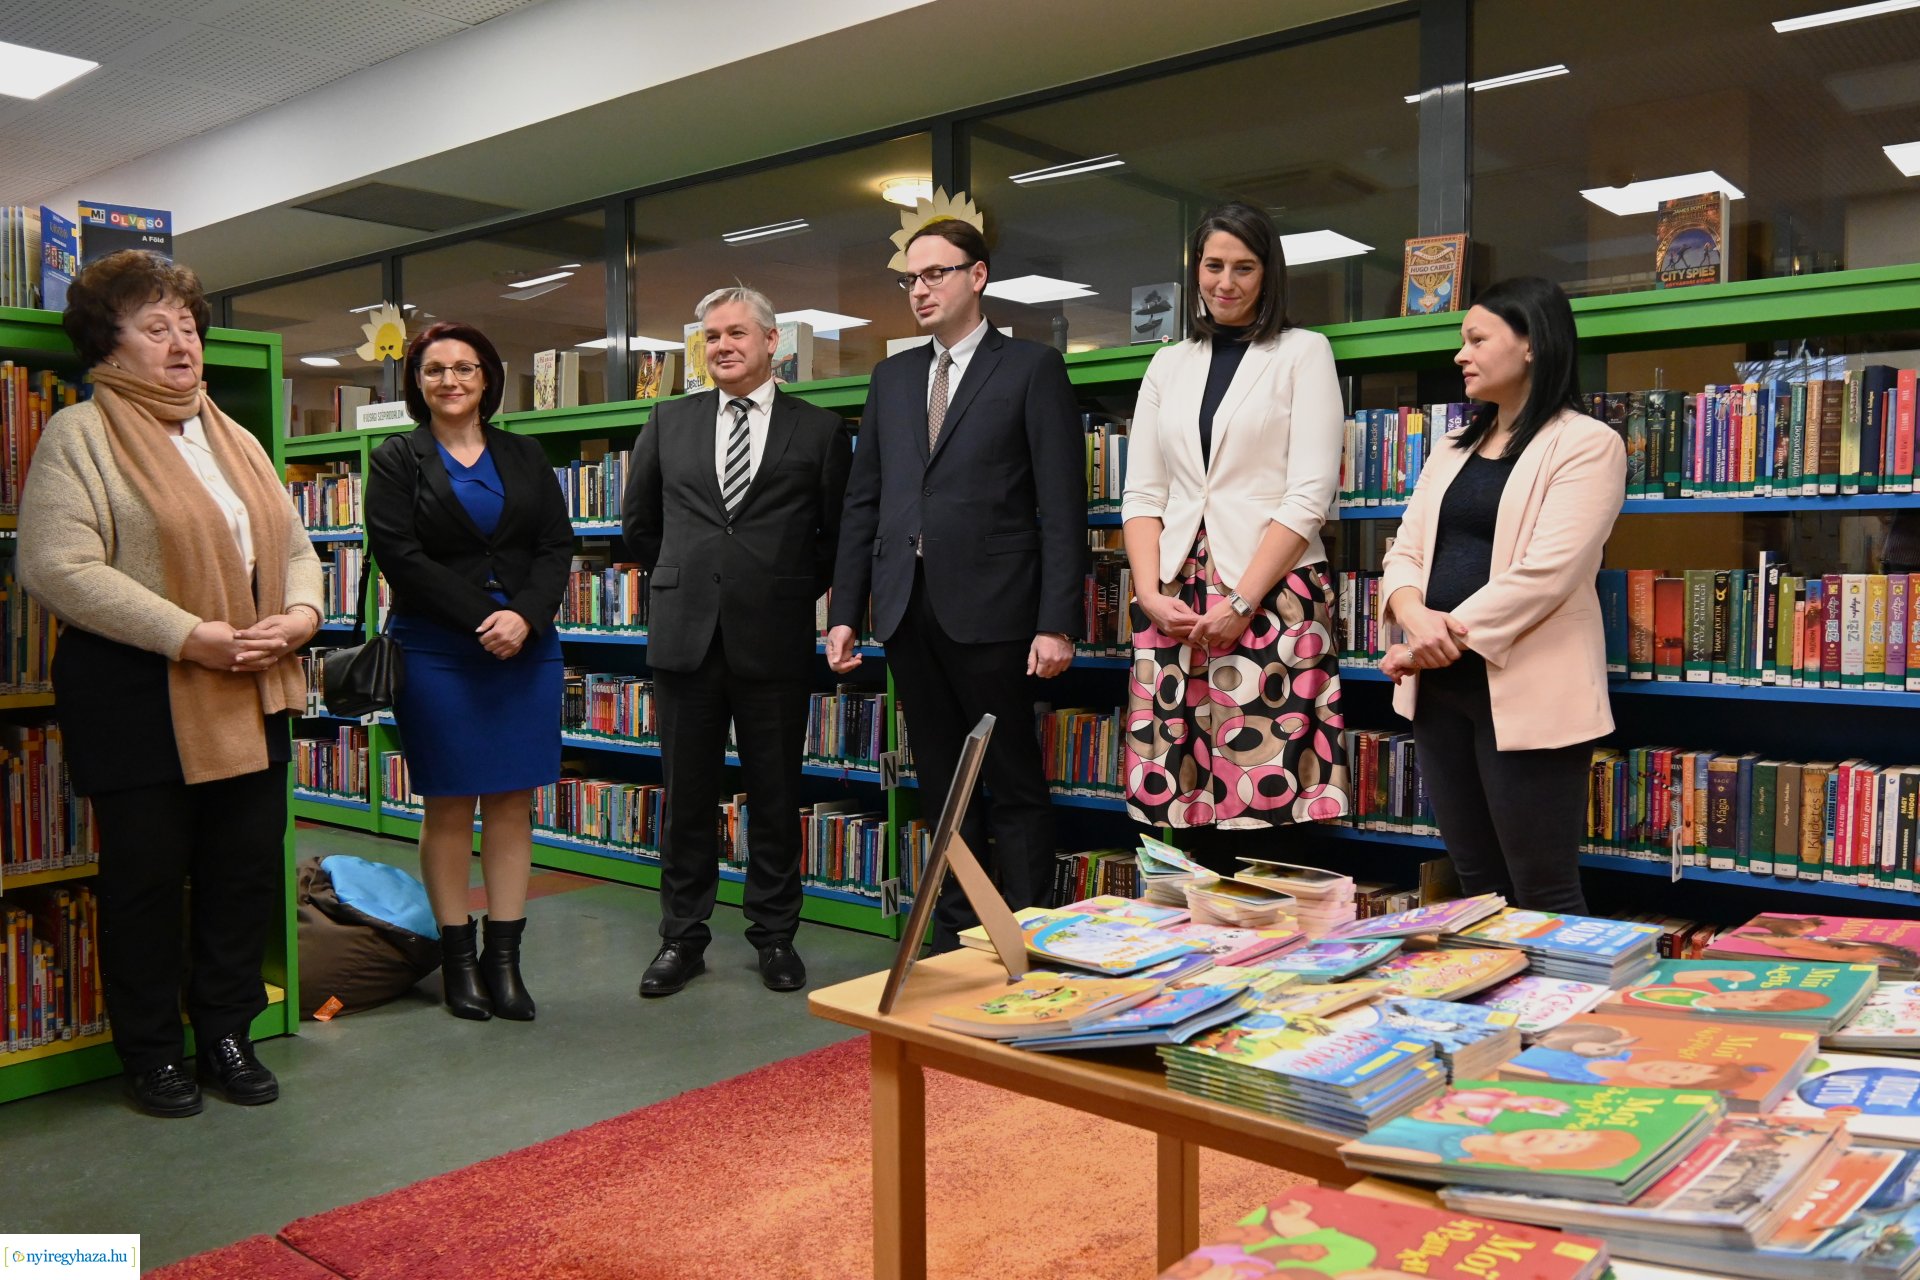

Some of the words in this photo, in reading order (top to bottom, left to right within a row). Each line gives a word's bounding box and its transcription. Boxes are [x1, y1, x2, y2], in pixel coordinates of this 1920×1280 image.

[91, 210, 104, 219] Mi
[110, 213, 164, 229] OLVASÓ
[1410, 265, 1429, 273] HUGO
[1429, 262, 1455, 272] CABRET
[1660, 268, 1686, 282] CITY
[1686, 265, 1716, 278] SPIES
[1097, 585, 1107, 615] ATTILA
[1109, 583, 1119, 613] ATTILA
[1714, 605, 1722, 629] POTTER
[1714, 629, 1722, 652] HARRY
[884, 755, 897, 787] N
[1862, 775, 1873, 814] gyermekei
[1900, 796, 1908, 814] NAGY
[1907, 792, 1916, 820] SÁNDOR
[1716, 798, 1730, 824] Mágia
[1807, 798, 1821, 849] Küldetés
[1861, 814, 1870, 838] Bambi
[885, 884, 898, 914] N
